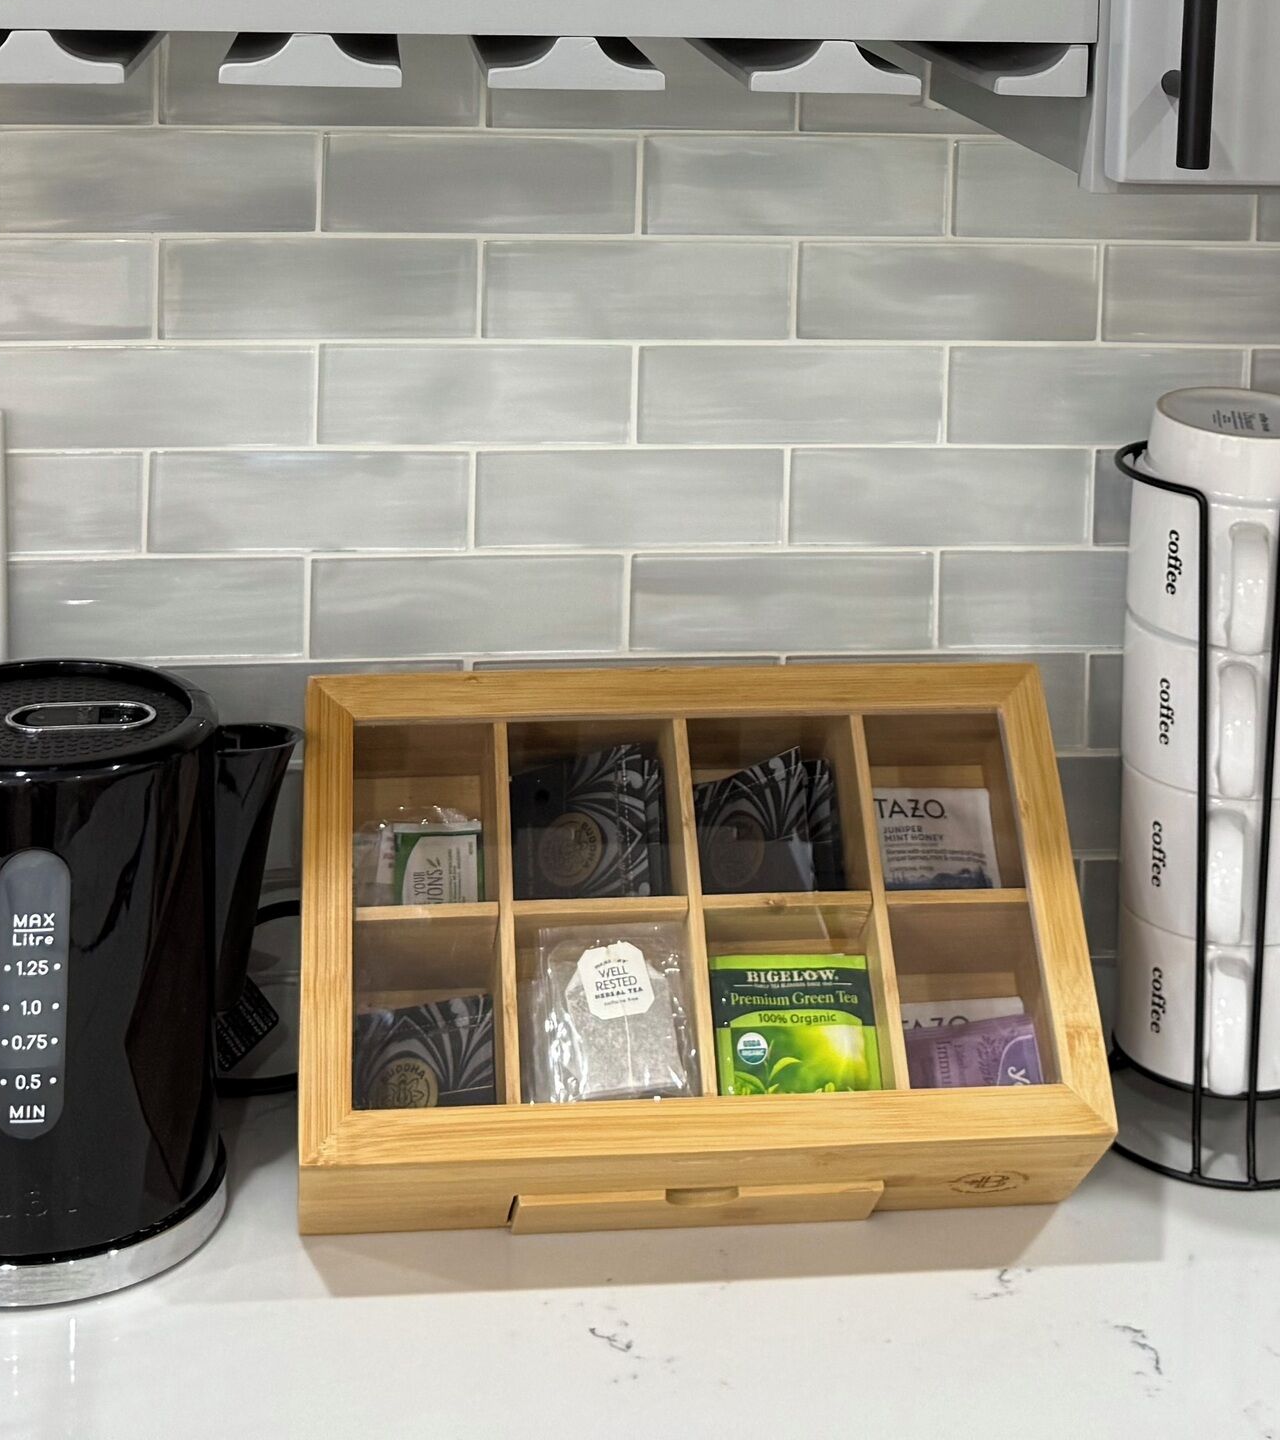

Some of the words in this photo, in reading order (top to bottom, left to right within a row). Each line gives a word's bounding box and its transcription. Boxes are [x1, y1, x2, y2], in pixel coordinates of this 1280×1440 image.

[1165, 529, 1183, 596] coffee
[1158, 677, 1175, 746] coffee
[873, 798, 945, 819] TAZO
[883, 825, 923, 835] JUNIPER
[883, 833, 909, 842] MINT
[910, 833, 945, 842] HONEY
[1151, 820, 1167, 888] coffee
[412, 871, 426, 896] YOUR
[13, 913, 55, 928] MAX
[12, 934, 54, 946] Litre
[16, 960, 49, 976] 1.25
[598, 965, 629, 978] WELL
[746, 969, 837, 983] BIGELOW
[595, 975, 638, 991] RESTED
[628, 986, 644, 995] TEA
[730, 992, 790, 1006] Premium
[792, 992, 834, 1004] Green
[836, 990, 859, 1004] Tea
[1151, 966, 1166, 1034] coffee
[21, 1000, 42, 1016] 1.0
[758, 1013, 788, 1024] 100%
[790, 1013, 838, 1026] Organic
[11, 1034, 48, 1051] 0.75
[15, 1074, 41, 1090] 0.5
[9, 1105, 45, 1119] MIN
